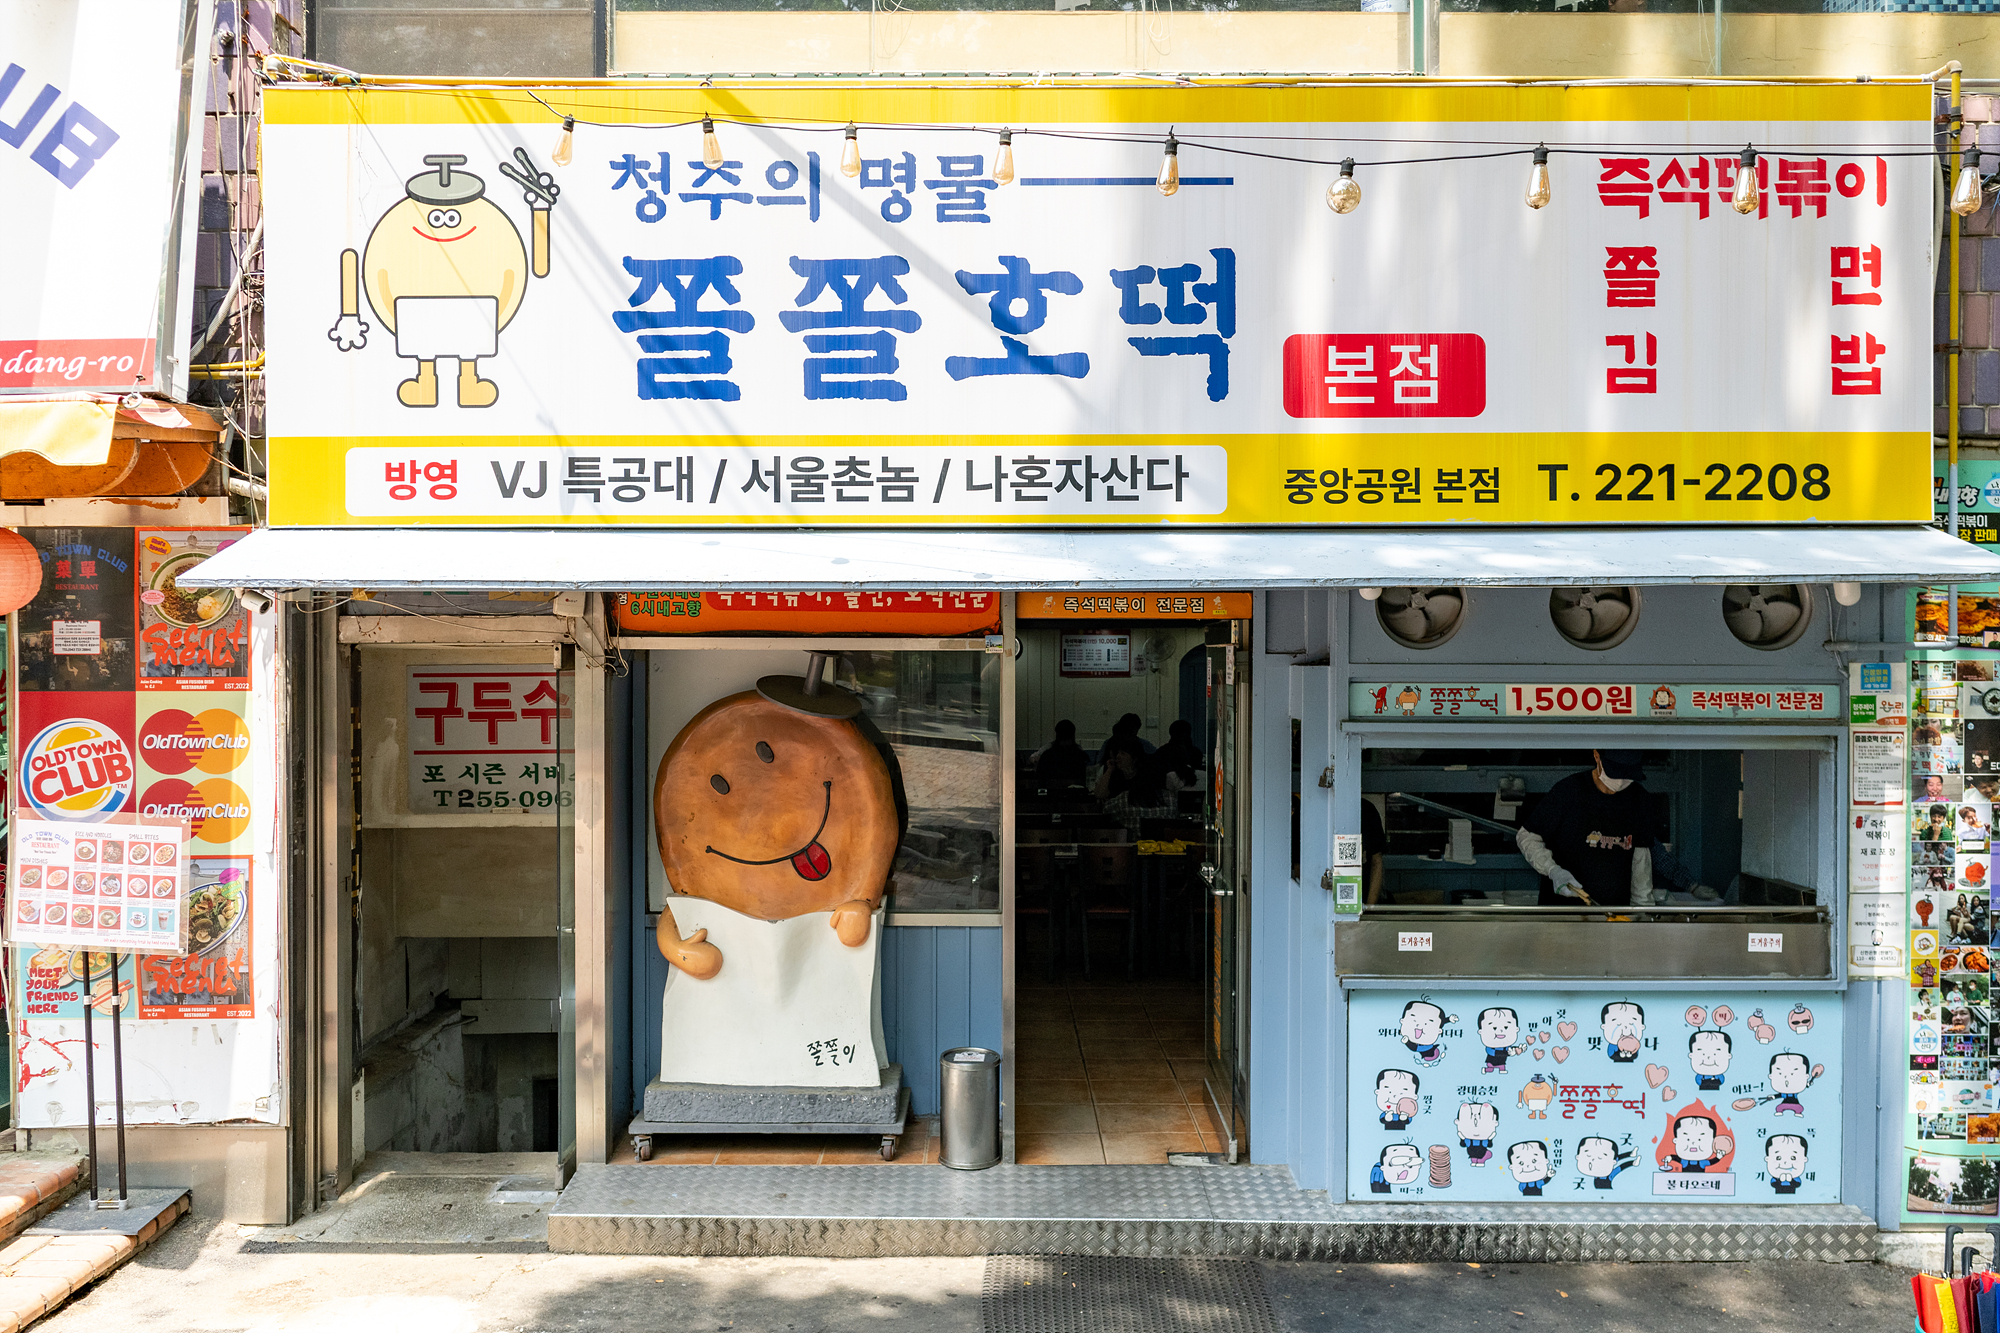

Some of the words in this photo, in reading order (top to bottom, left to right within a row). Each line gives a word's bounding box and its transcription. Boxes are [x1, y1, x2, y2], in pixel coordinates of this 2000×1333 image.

[609, 150, 820, 223] 청주의
[860, 150, 998, 223] 명물
[1597, 155, 1887, 220] 즉석떡볶이
[613, 248, 1236, 402] 쫄쫄호떡
[0, 350, 134, 380] dang-ro
[1324, 344, 1438, 404] 본점
[385, 459, 457, 501] 방영
[490, 461, 548, 499] VJ
[563, 455, 694, 503] 특공대
[741, 456, 920, 503] 서울촌놈
[966, 454, 1190, 503] 나혼자산다
[1283, 467, 1421, 504] 중앙공원
[1434, 467, 1501, 504] 본점
[1537, 464, 1581, 502] T.
[1595, 463, 1831, 502] 221-2208
[1934, 486, 1978, 506] 내향
[1974, 529, 1998, 542] 판매
[55, 544, 92, 556] TOWN
[97, 548, 128, 573] CLUB
[631, 600, 702, 617] 6시내고향
[1064, 596, 1145, 613] 즉석떡볶이
[1157, 596, 1205, 613] 전문점
[142, 619, 243, 652] Secret
[152, 643, 235, 666] menu
[415, 680, 572, 745] 구두수
[1430, 686, 1498, 715] 쫄쫄호떡
[1512, 686, 1632, 716] 1,500원
[1691, 690, 1772, 711] 즉석떡볶이
[1775, 691, 1824, 711] 전문점
[31, 739, 122, 771] OLDTOWN
[142, 733, 249, 750] OldTownClub
[31, 753, 132, 804] CLUB
[422, 765, 446, 783] 포
[458, 763, 507, 785] 시즌
[143, 803, 249, 819] OldTownClub
[1870, 820, 1886, 829] 즉석
[21, 833, 33, 843] OLD
[31, 841, 60, 849] RESTAURANT
[1866, 831, 1890, 840] 떡볶이
[143, 948, 244, 980] Secret
[26, 979, 60, 990] YOUR
[26, 991, 78, 1002] FRIENDS
[153, 972, 237, 994] menu
[807, 1038, 856, 1066] 쫄쫄이
[1457, 1085, 1498, 1096] 광대승천
[1559, 1083, 1645, 1119] 쫄쫄호떡
[1667, 1179, 1677, 1190] 불
[1680, 1179, 1721, 1190] 타오르네
